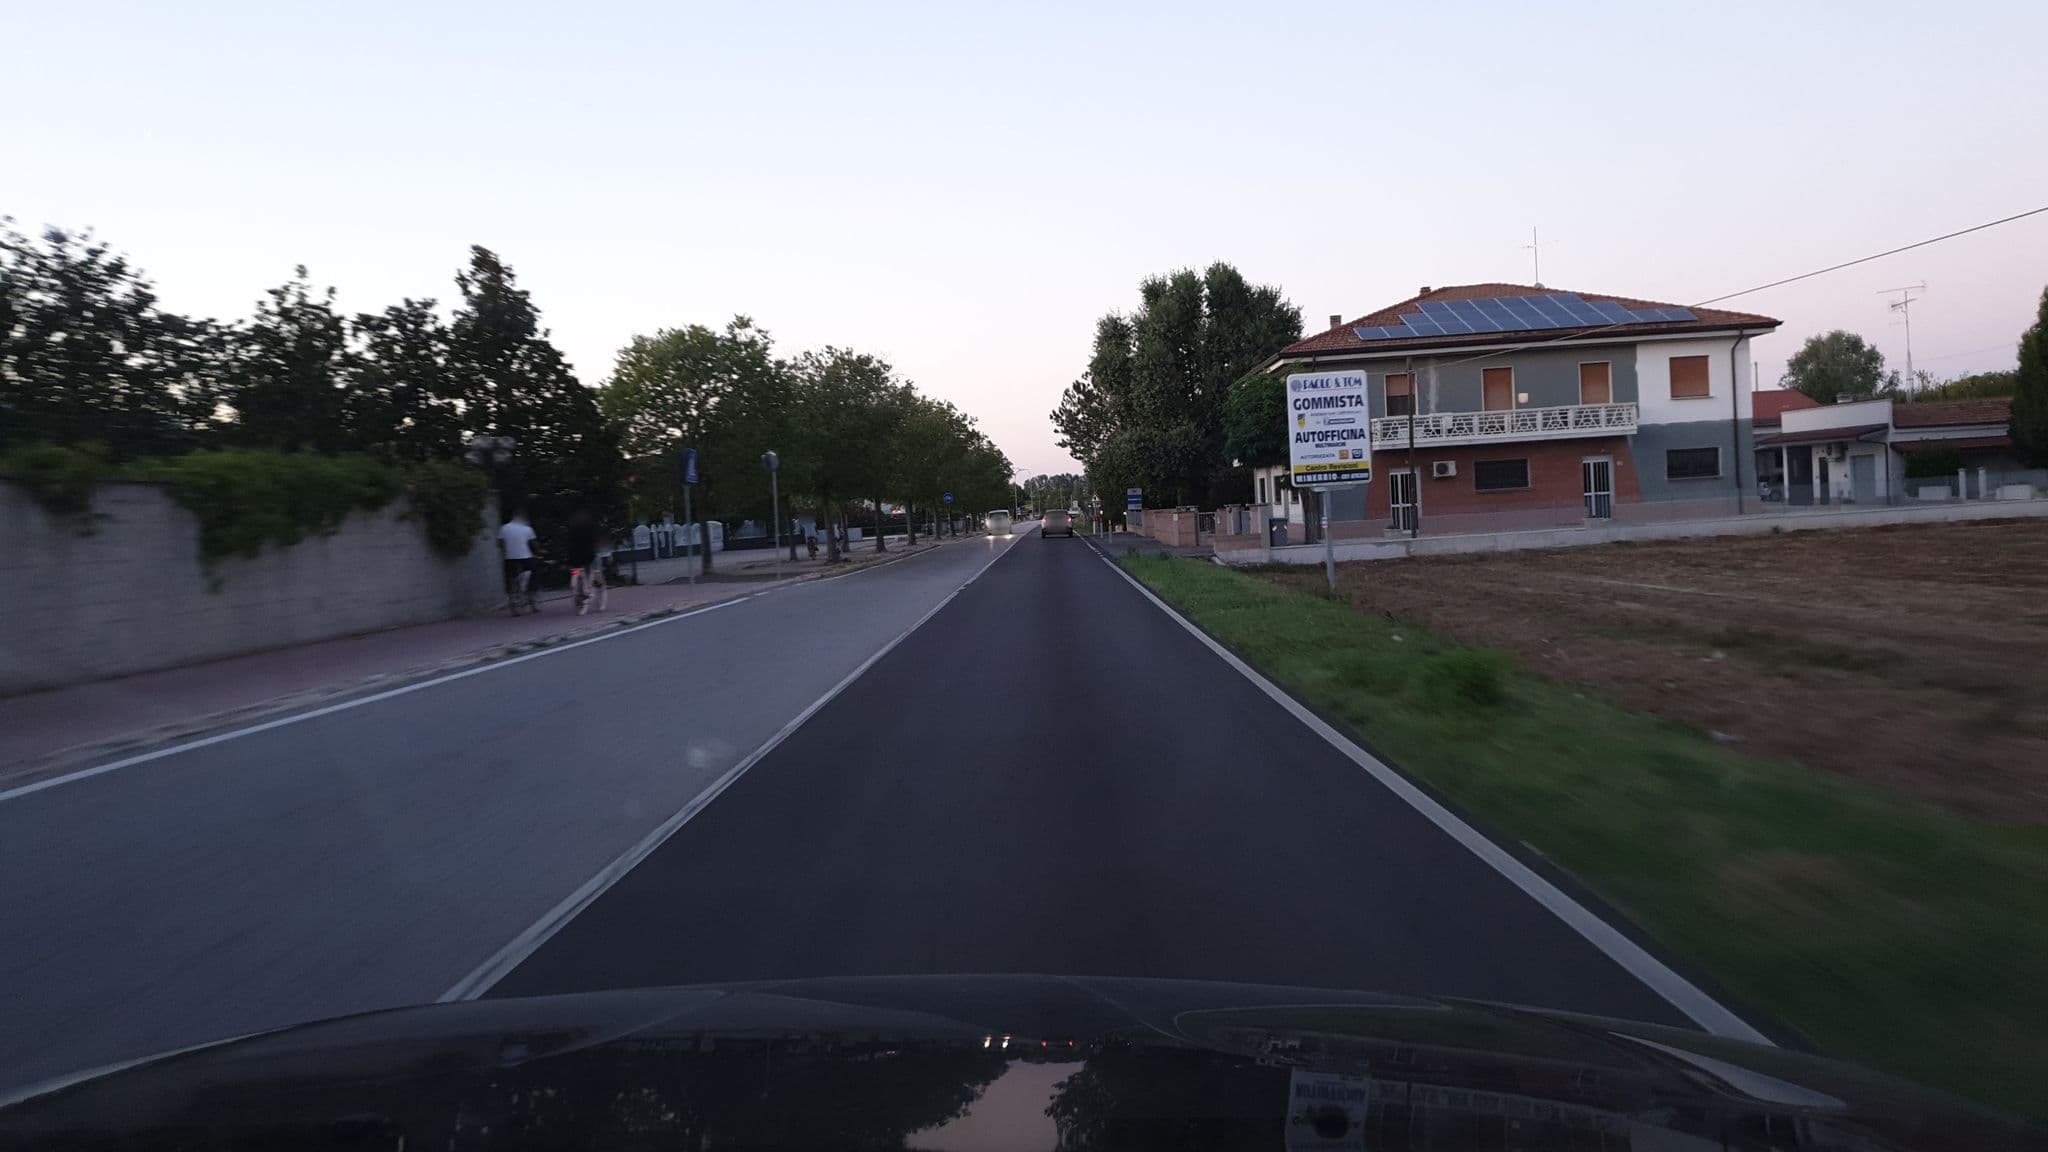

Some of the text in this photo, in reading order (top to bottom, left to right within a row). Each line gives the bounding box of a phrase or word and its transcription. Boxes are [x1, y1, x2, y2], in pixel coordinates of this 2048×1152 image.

[1335, 377, 1341, 387] &
[1343, 376, 1362, 387] TOM
[1293, 394, 1364, 411] GOMMISTA
[1295, 428, 1366, 444] AUTOFFICINA
